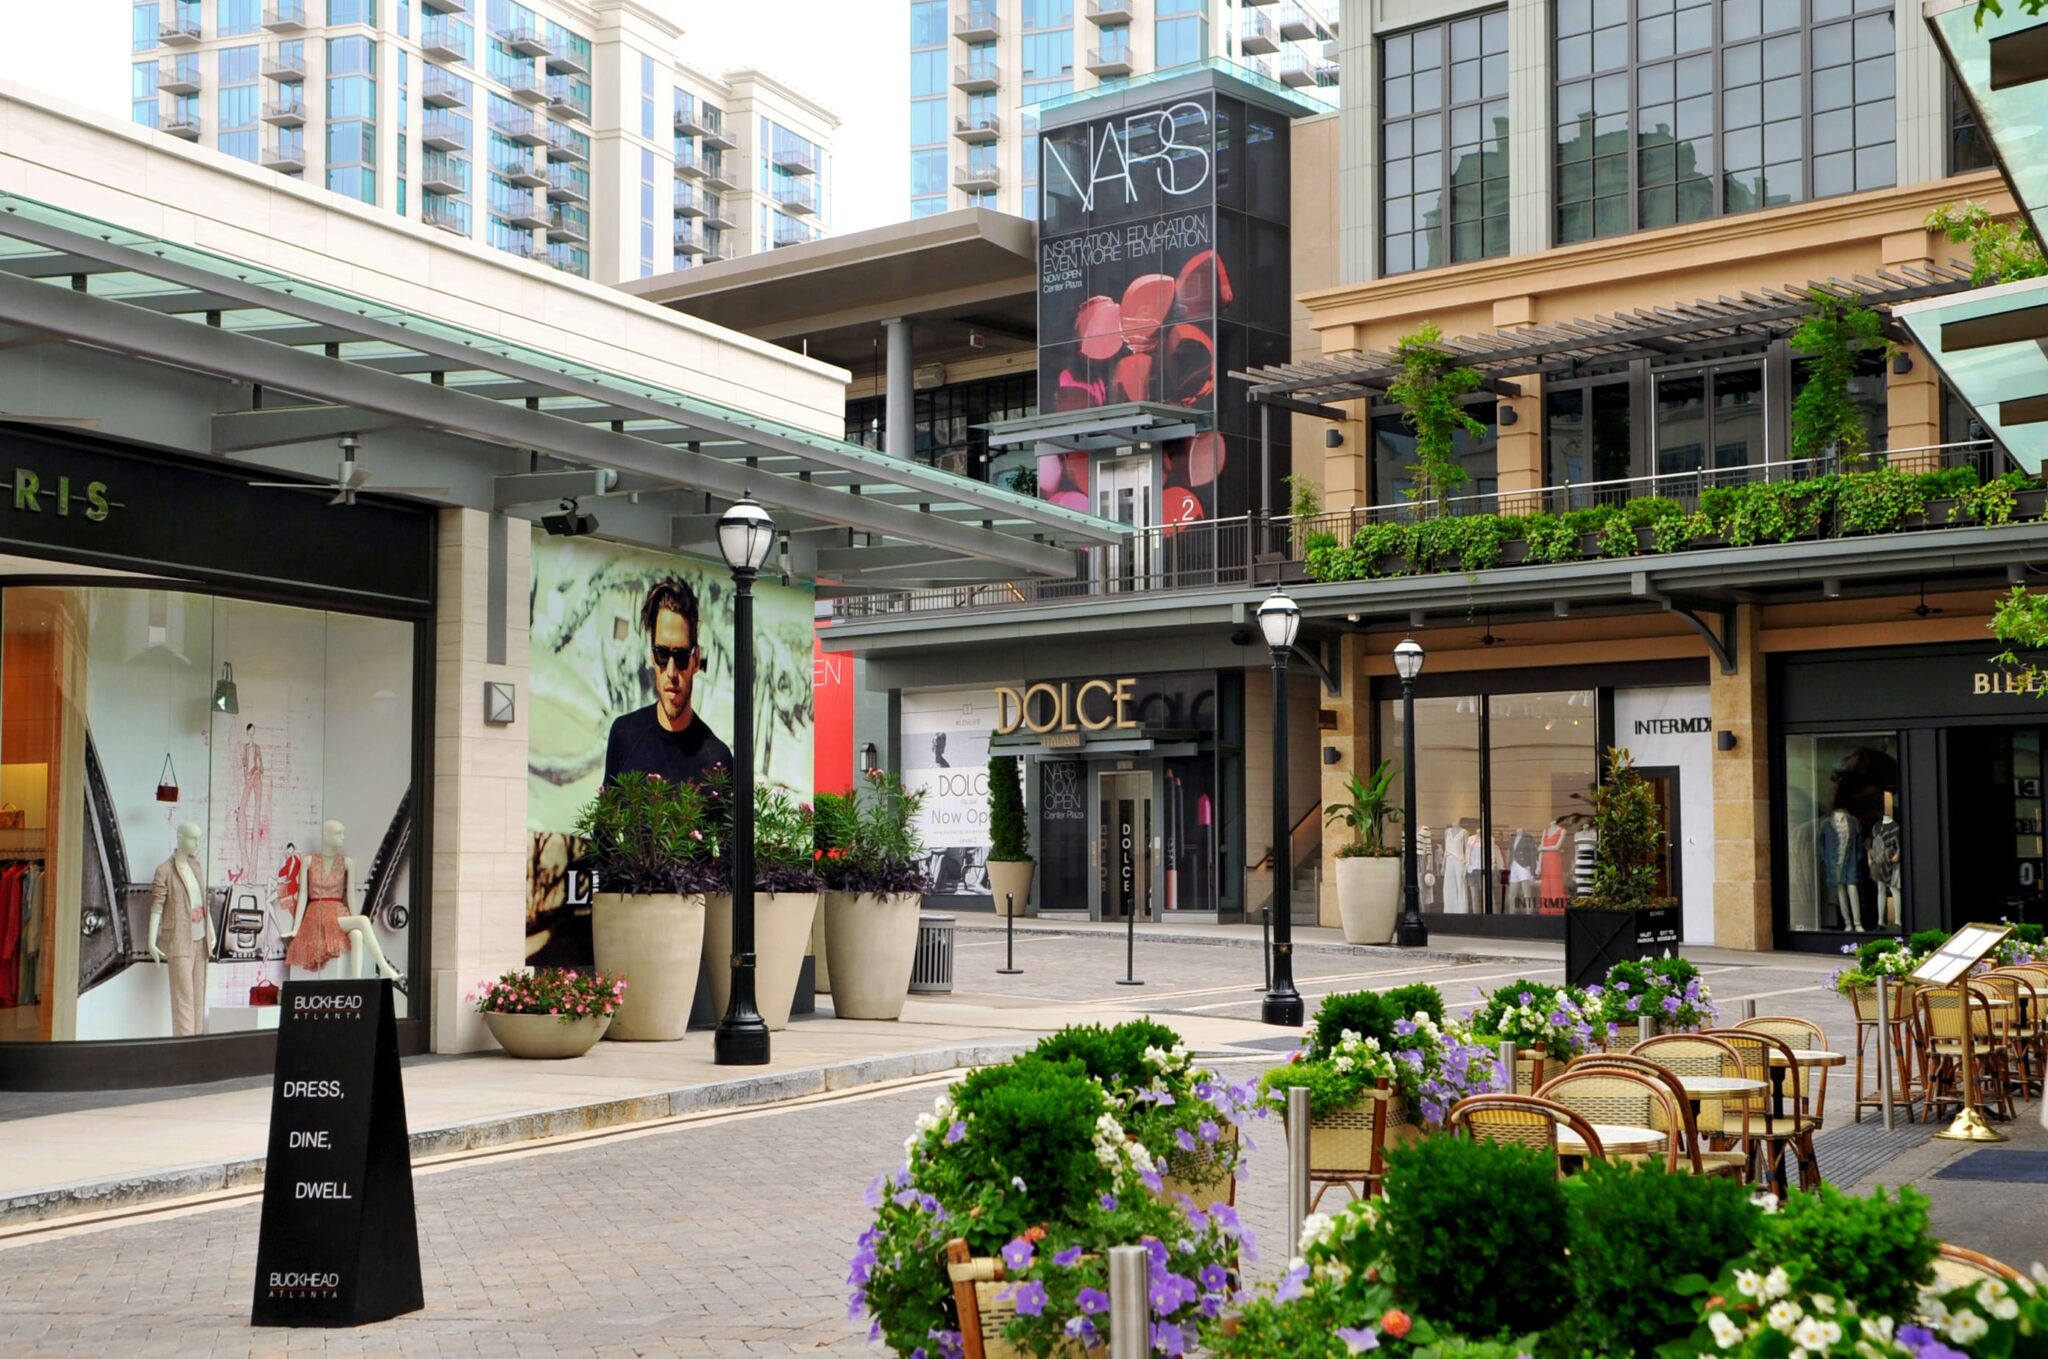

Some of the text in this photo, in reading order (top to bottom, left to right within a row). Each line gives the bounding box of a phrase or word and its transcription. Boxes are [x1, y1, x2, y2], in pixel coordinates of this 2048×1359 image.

[1043, 101, 1209, 221] NARS
[1043, 255, 1077, 275] EVEN
[1081, 245, 1121, 266] MORE
[1043, 269, 1082, 284] NOW OPEN
[1043, 279, 1083, 293] Center Plaza
[1182, 498, 1194, 521] 2
[994, 678, 1138, 735] DOLCE
[1635, 717, 1712, 735] INTERMIX
[1044, 763, 1077, 780] NARS
[939, 773, 989, 798] DOLC
[1044, 778, 1077, 795] NOW
[1044, 793, 1081, 810] OPEN
[931, 808, 988, 827] Now Op
[1044, 810, 1084, 820] Center Plaza
[1121, 823, 1132, 893] DOLCE
[294, 994, 363, 1010] BUCKHEAD
[293, 1011, 361, 1020] ATLANTA
[283, 1080, 345, 1099] DRESS,
[289, 1131, 332, 1150] DINE,
[295, 1182, 352, 1199] DWELL
[269, 1272, 339, 1288] BUCKHEAD
[268, 1290, 338, 1299] ATLANTA
